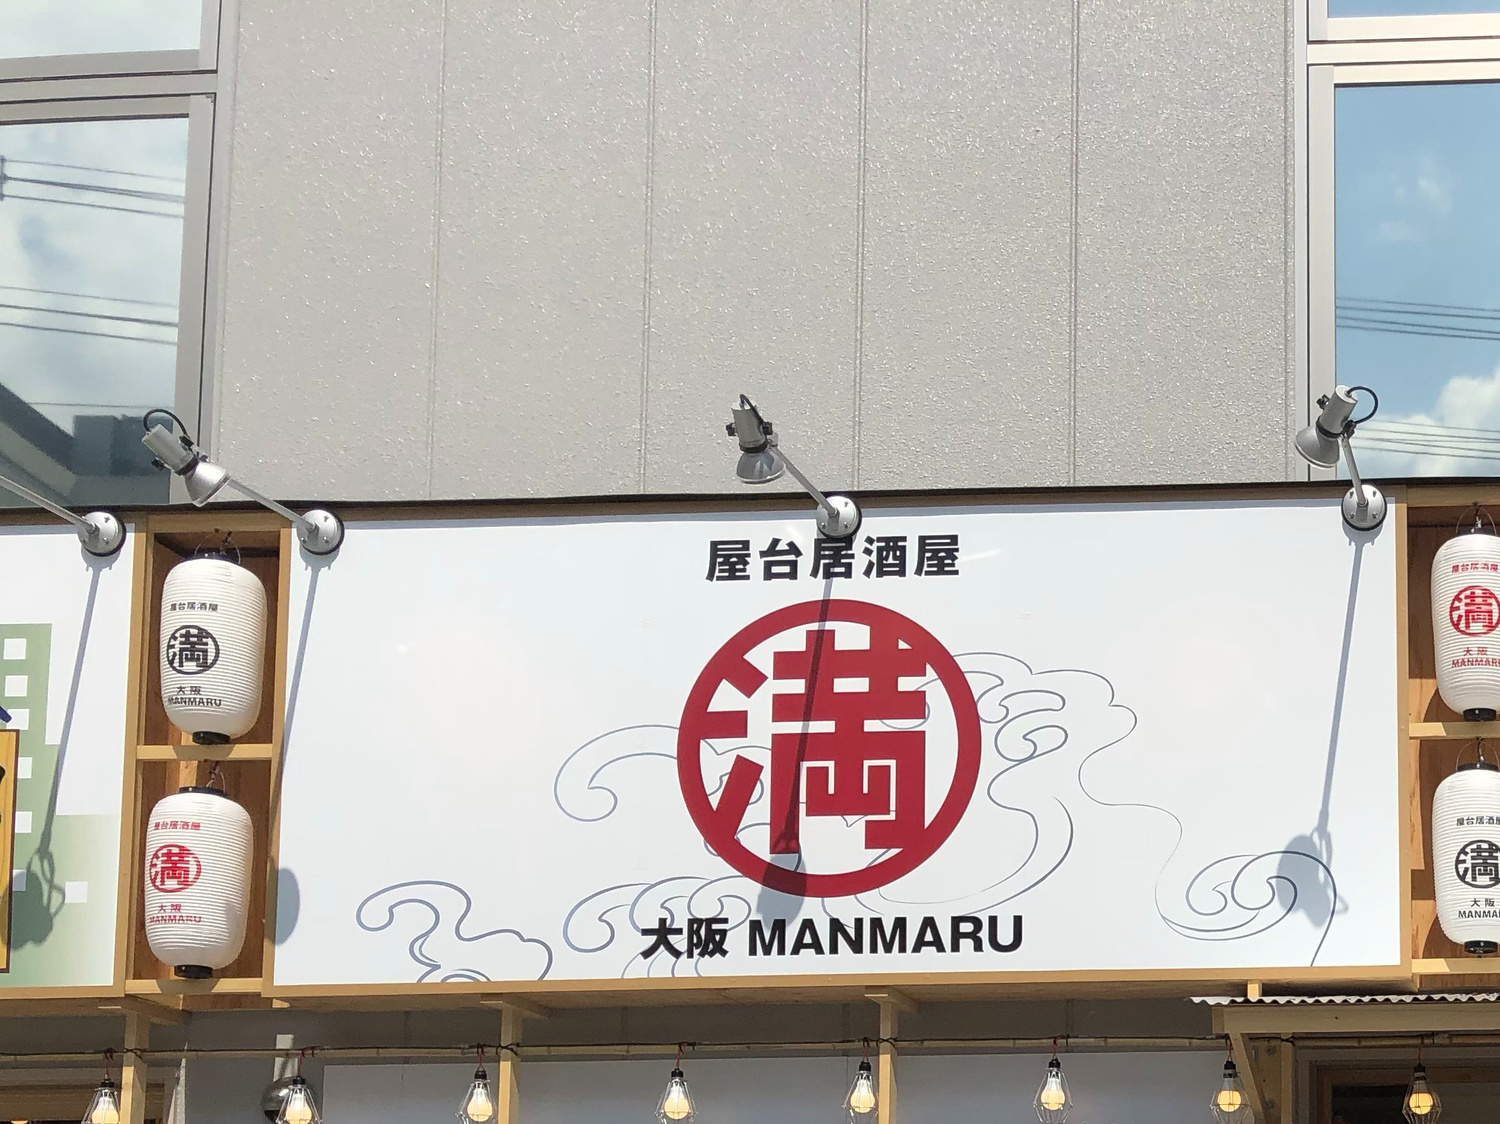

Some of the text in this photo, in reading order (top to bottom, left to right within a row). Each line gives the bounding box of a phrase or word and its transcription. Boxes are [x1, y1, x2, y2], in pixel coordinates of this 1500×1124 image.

[705, 534, 961, 582] 屋台居酒屋
[166, 625, 220, 675] 満
[1462, 646, 1488, 657] 大阪
[176, 685, 202, 696] 大阪
[677, 599, 982, 897] 満
[149, 842, 201, 892] 満
[157, 902, 182, 913] 大阪
[1470, 898, 1496, 909] 大阪
[640, 914, 1023, 959] 大阪 MANMARU
